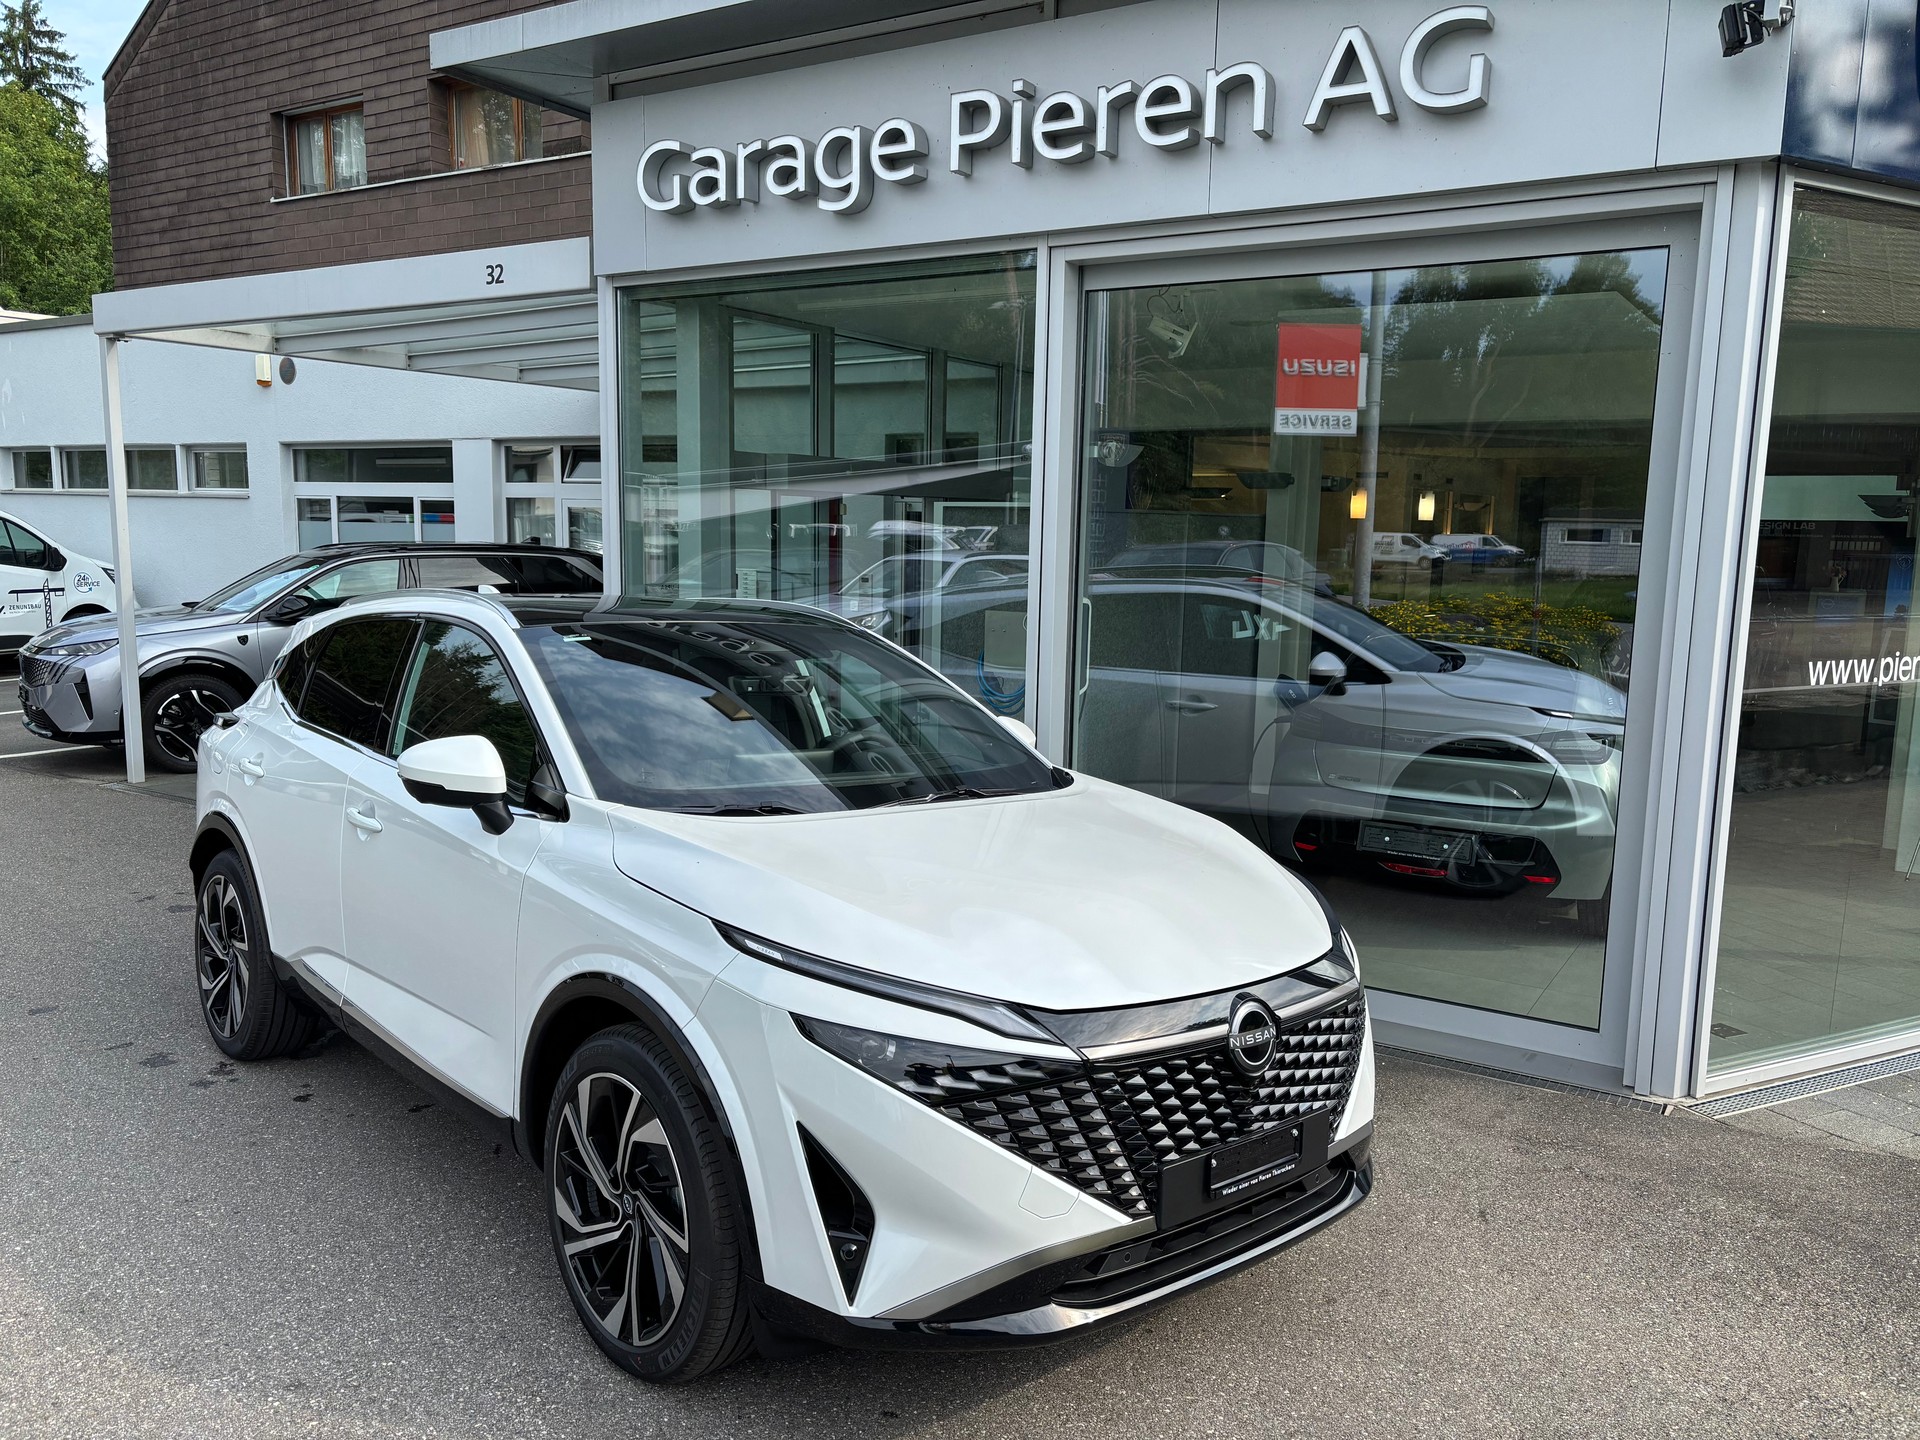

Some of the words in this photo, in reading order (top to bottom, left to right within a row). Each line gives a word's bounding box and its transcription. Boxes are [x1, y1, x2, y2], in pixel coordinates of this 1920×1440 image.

[636, 117, 928, 215] Garage
[949, 61, 1275, 176] Pieren
[1302, 4, 1495, 132] AG
[485, 263, 505, 285] 32
[1793, 521, 1816, 530] LAB
[1808, 651, 1920, 686] www.pier
[1229, 1026, 1276, 1049] NISSAN
[1222, 1185, 1239, 1196] Wieder
